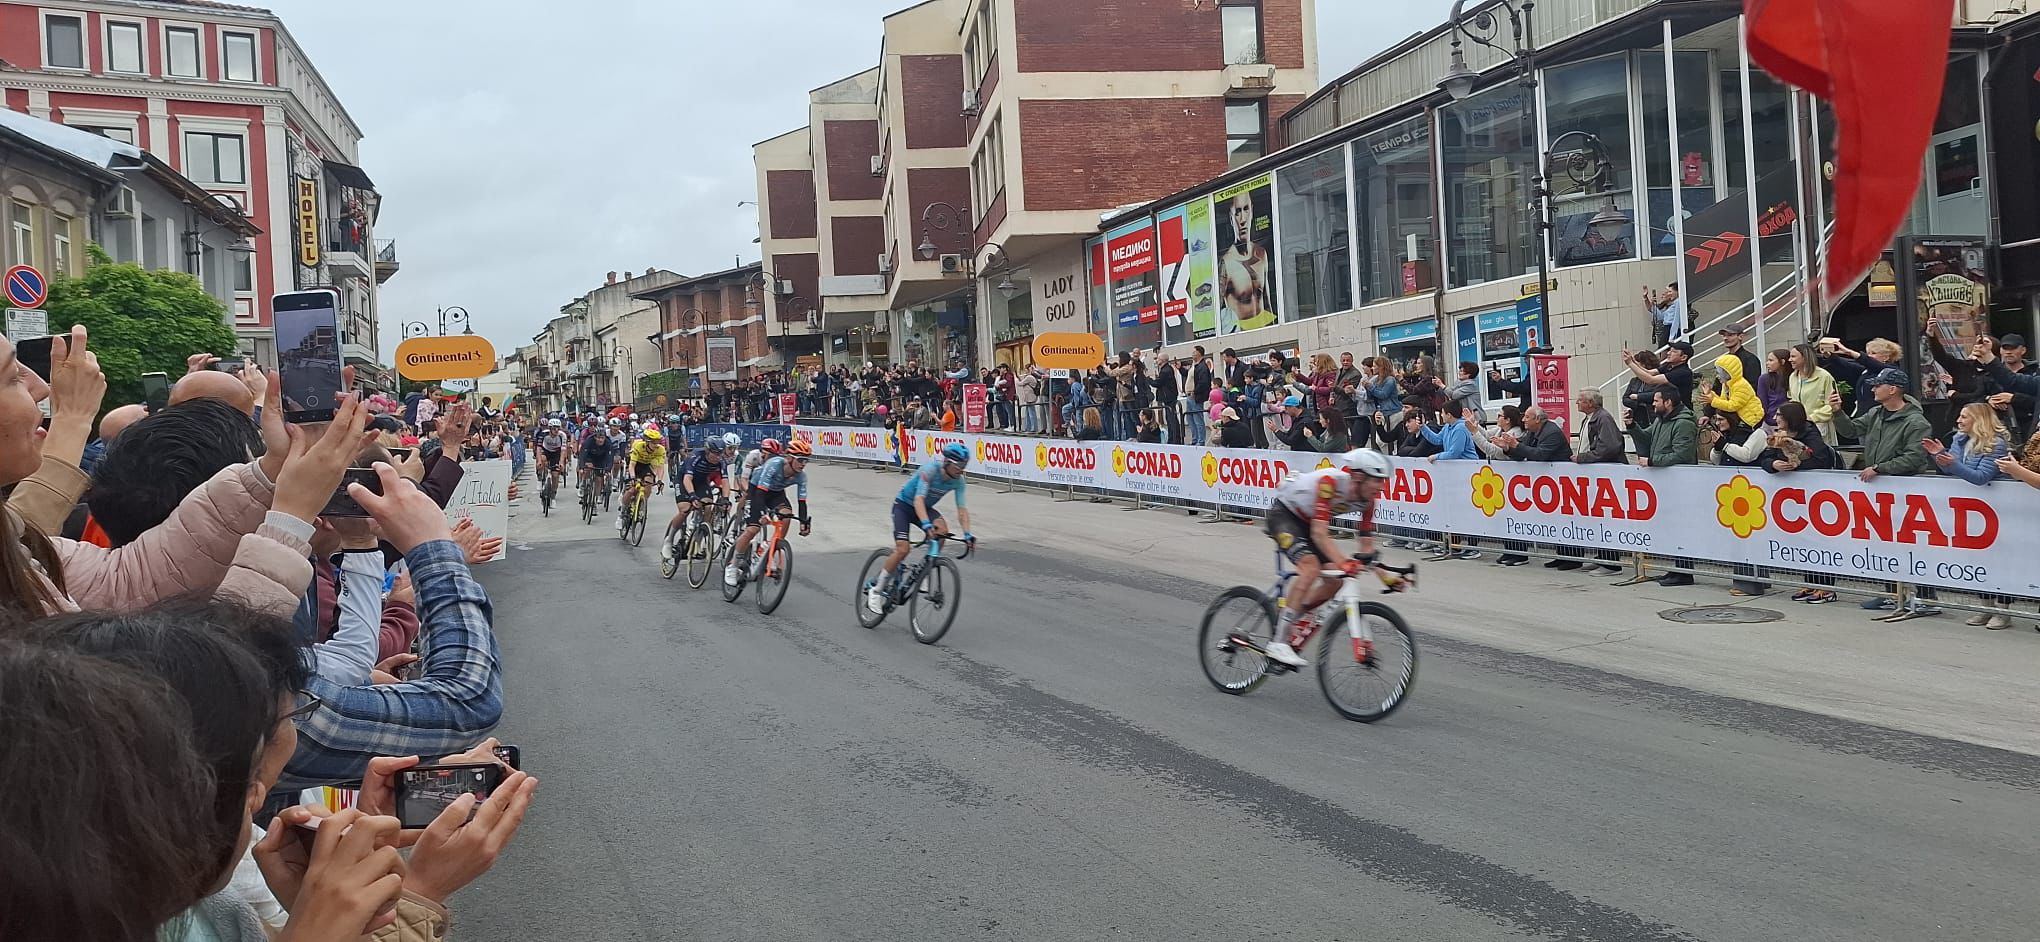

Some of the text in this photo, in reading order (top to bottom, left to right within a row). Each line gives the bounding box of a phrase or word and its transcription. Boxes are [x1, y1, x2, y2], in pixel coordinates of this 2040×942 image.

[1372, 134, 1411, 153] TEMPO
[300, 182, 315, 261] HOTEL
[1759, 206, 1796, 236] ВХОД
[1112, 238, 1151, 262] МЕДИКО
[1044, 275, 1074, 299] LADY
[1046, 300, 1076, 322] GOLD
[1041, 345, 1088, 356] Continental
[1460, 337, 1476, 347] VELO
[406, 351, 472, 366] Continental
[823, 431, 843, 446] CONAD
[855, 432, 878, 448] CONAD
[985, 443, 1022, 464] CONAD
[1048, 447, 1096, 470] CONAD
[1127, 450, 1181, 479] CONAD
[1218, 457, 1289, 489] CONAD
[460, 480, 501, 505] d'Italia
[1126, 478, 1180, 494] Persone oltre le cose
[1218, 488, 1243, 502] Persone
[1244, 489, 1260, 504] oltre
[1262, 491, 1269, 504] le
[1507, 474, 1658, 521] CONAD
[1374, 504, 1395, 520] oltre
[1397, 506, 1406, 522] le
[1409, 512, 1430, 525] cose
[1771, 487, 2000, 549] CONAD
[1506, 517, 1651, 546] Persone oltre le cose
[1769, 540, 1987, 582] Persone oltre le cose
